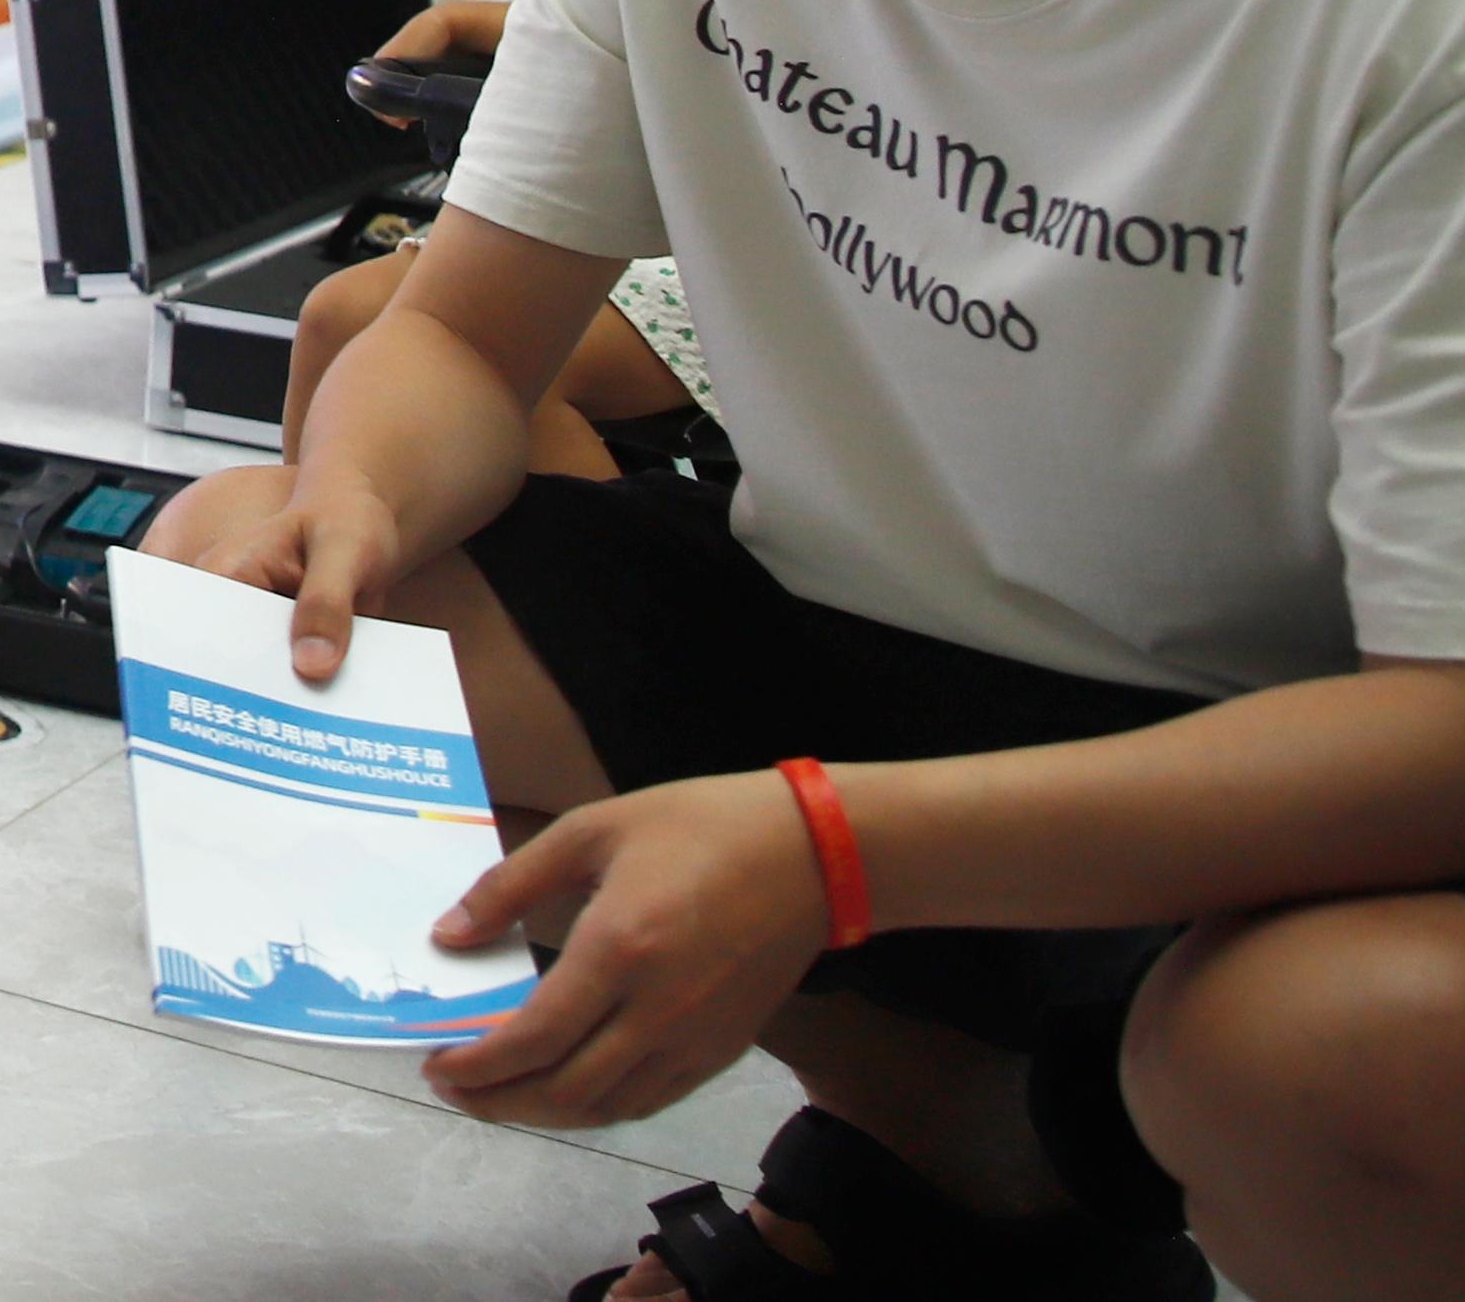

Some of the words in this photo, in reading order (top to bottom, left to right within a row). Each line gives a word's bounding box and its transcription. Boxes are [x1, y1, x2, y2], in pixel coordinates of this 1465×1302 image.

[168, 689, 448, 770] 居民安全使用燃气防护手册
